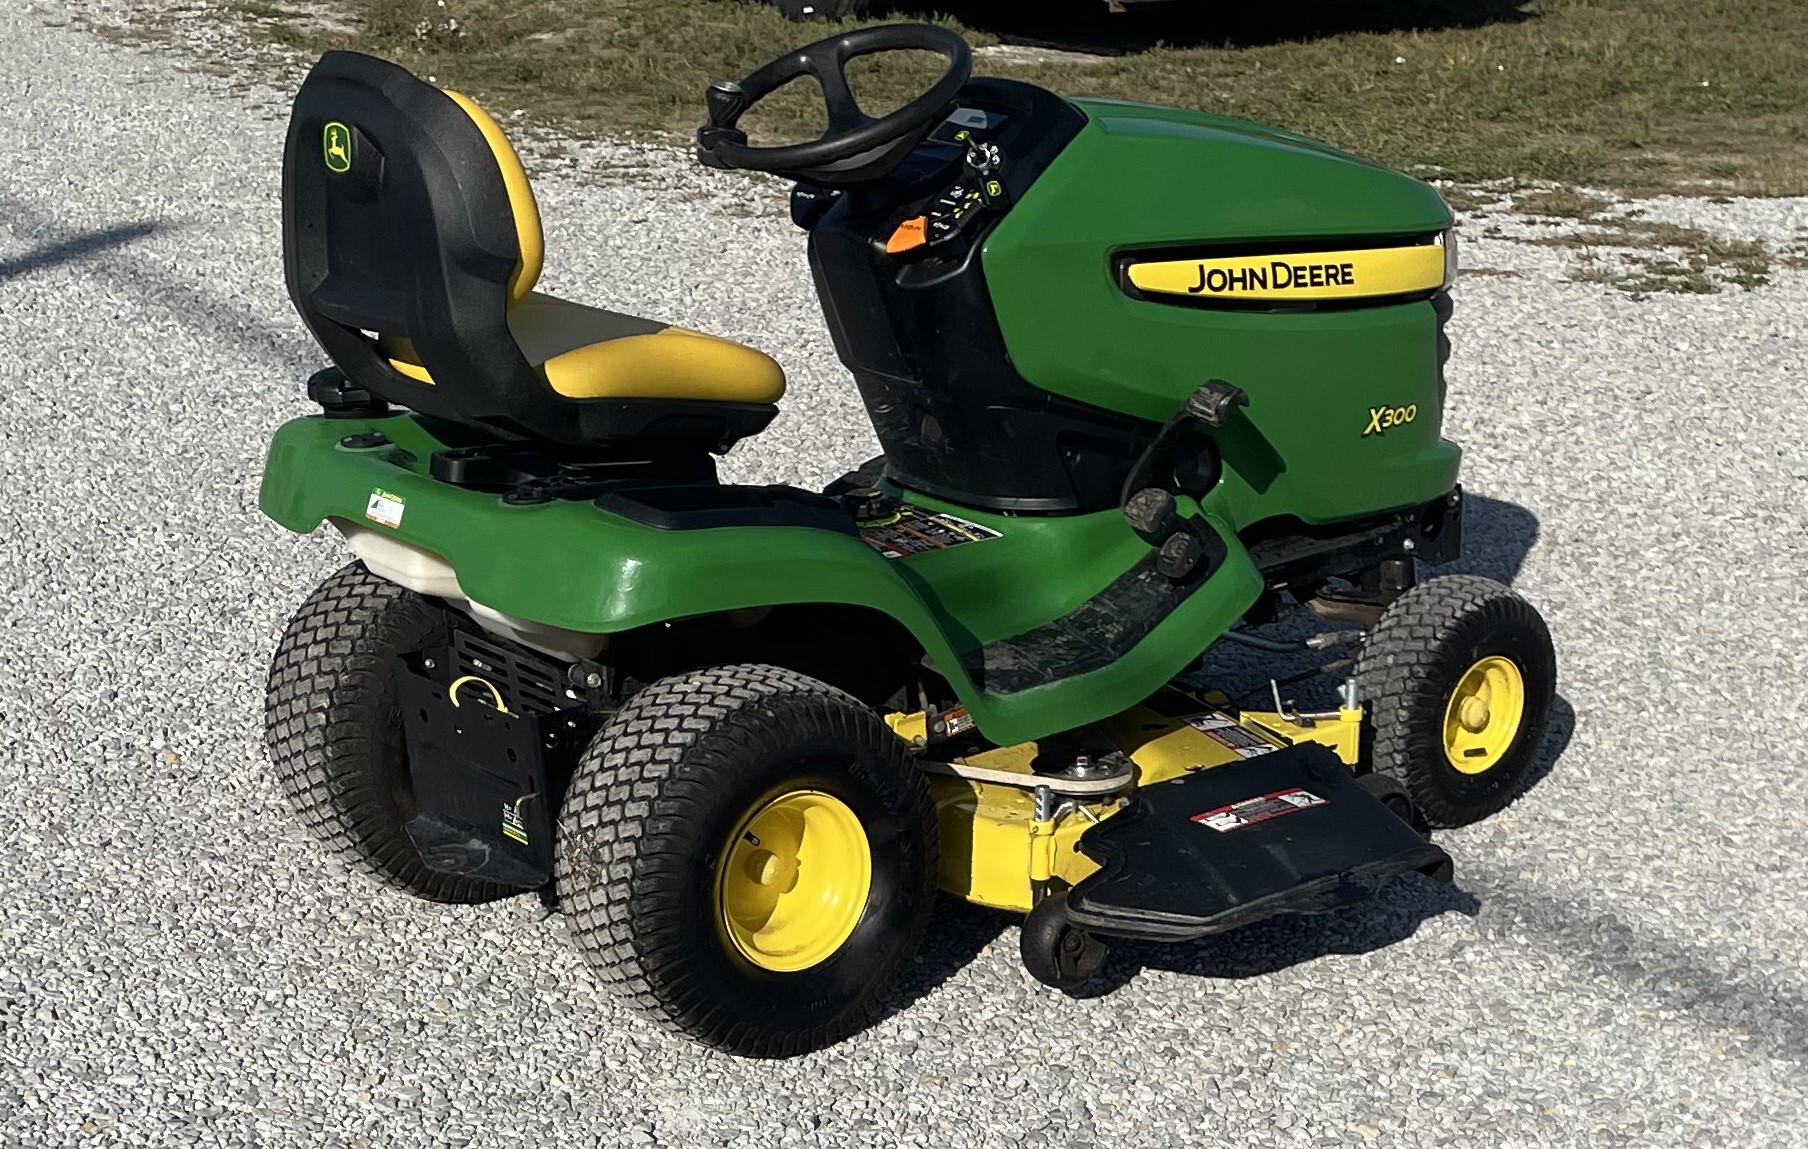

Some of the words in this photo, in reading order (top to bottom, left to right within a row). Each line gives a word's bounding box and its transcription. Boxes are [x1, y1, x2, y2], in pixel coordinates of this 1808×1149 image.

[1188, 264, 1268, 293] JOHN
[1270, 262, 1354, 289] DEERE
[1363, 404, 1417, 435] X300
